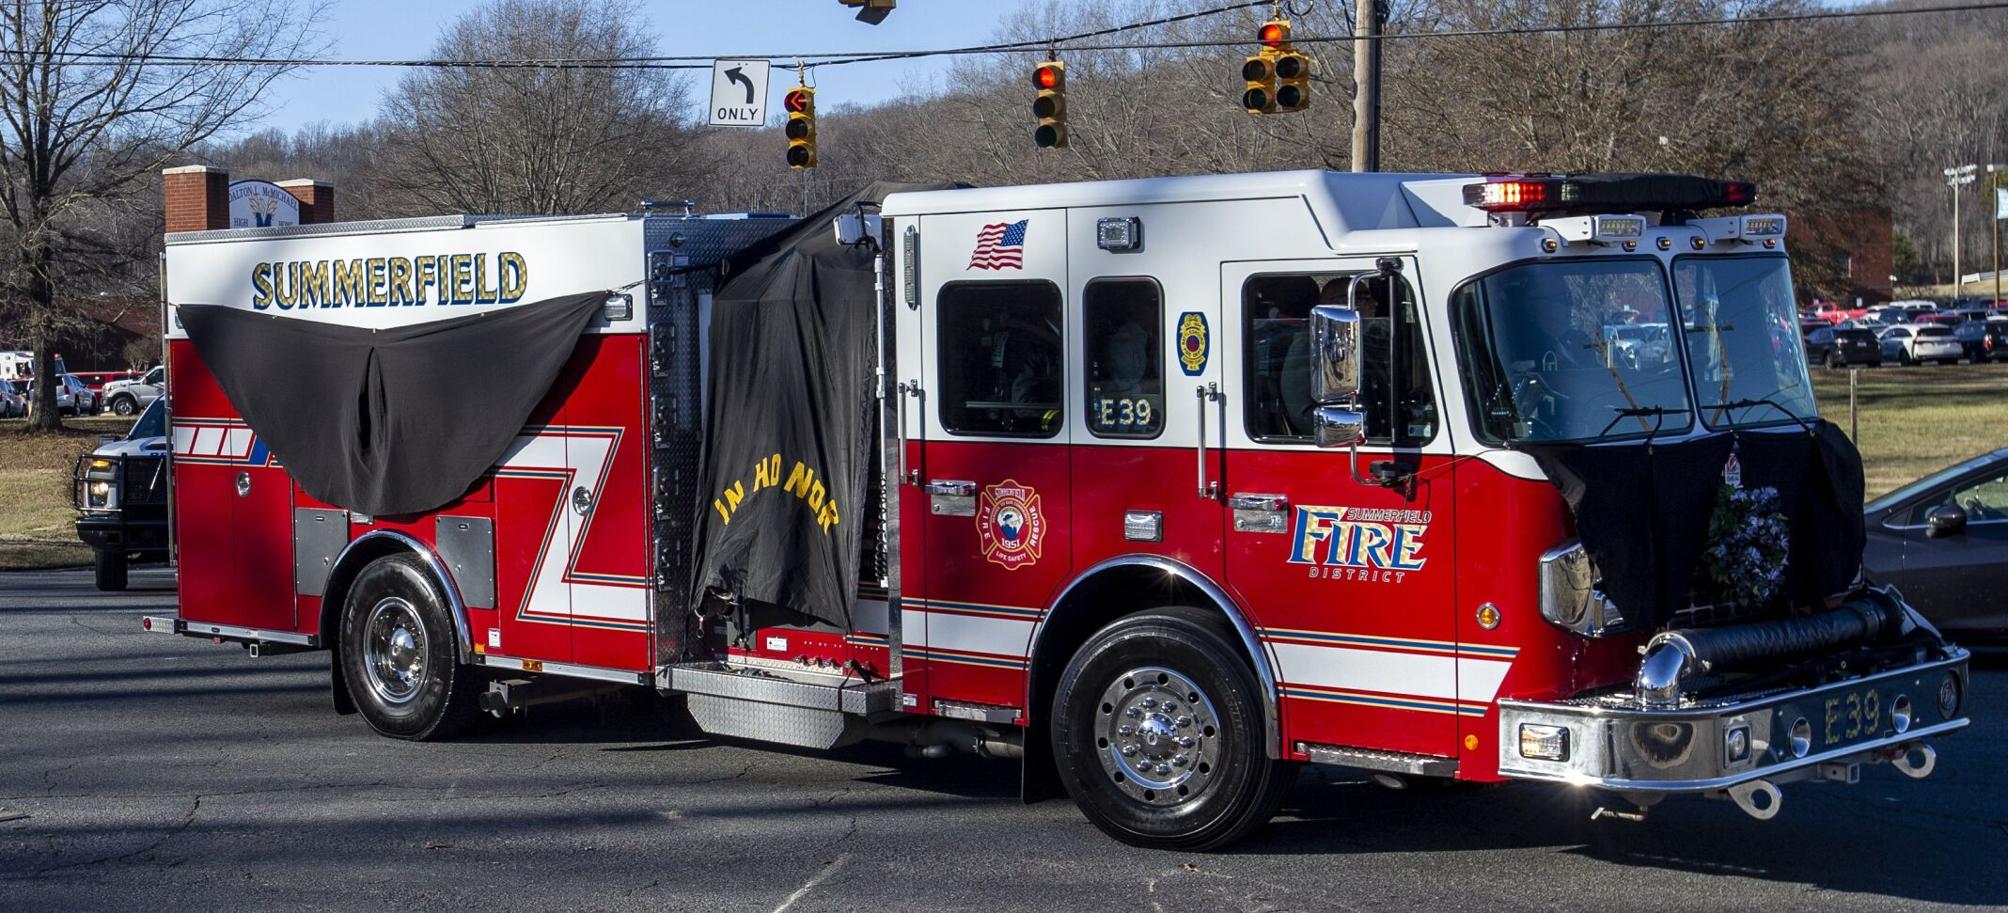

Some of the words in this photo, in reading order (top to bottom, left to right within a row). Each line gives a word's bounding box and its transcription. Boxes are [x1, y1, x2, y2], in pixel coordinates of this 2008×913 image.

[717, 107, 758, 121] ONLY
[252, 251, 528, 310] SUMMERFIELD
[1101, 399, 1151, 426] E39
[714, 479, 745, 526] IN
[753, 453, 840, 537] HONOR
[981, 506, 991, 540] FIRE
[1028, 505, 1040, 547] RESCUE
[1347, 507, 1432, 524] SUMMERFIELD
[1001, 537, 1020, 549] 1951
[1286, 504, 1428, 571] FIRE
[995, 550, 1007, 560] LIFE
[1007, 552, 1027, 562] SAFETY
[1308, 566, 1406, 584] DISTRICT
[1825, 689, 1880, 744] E39
